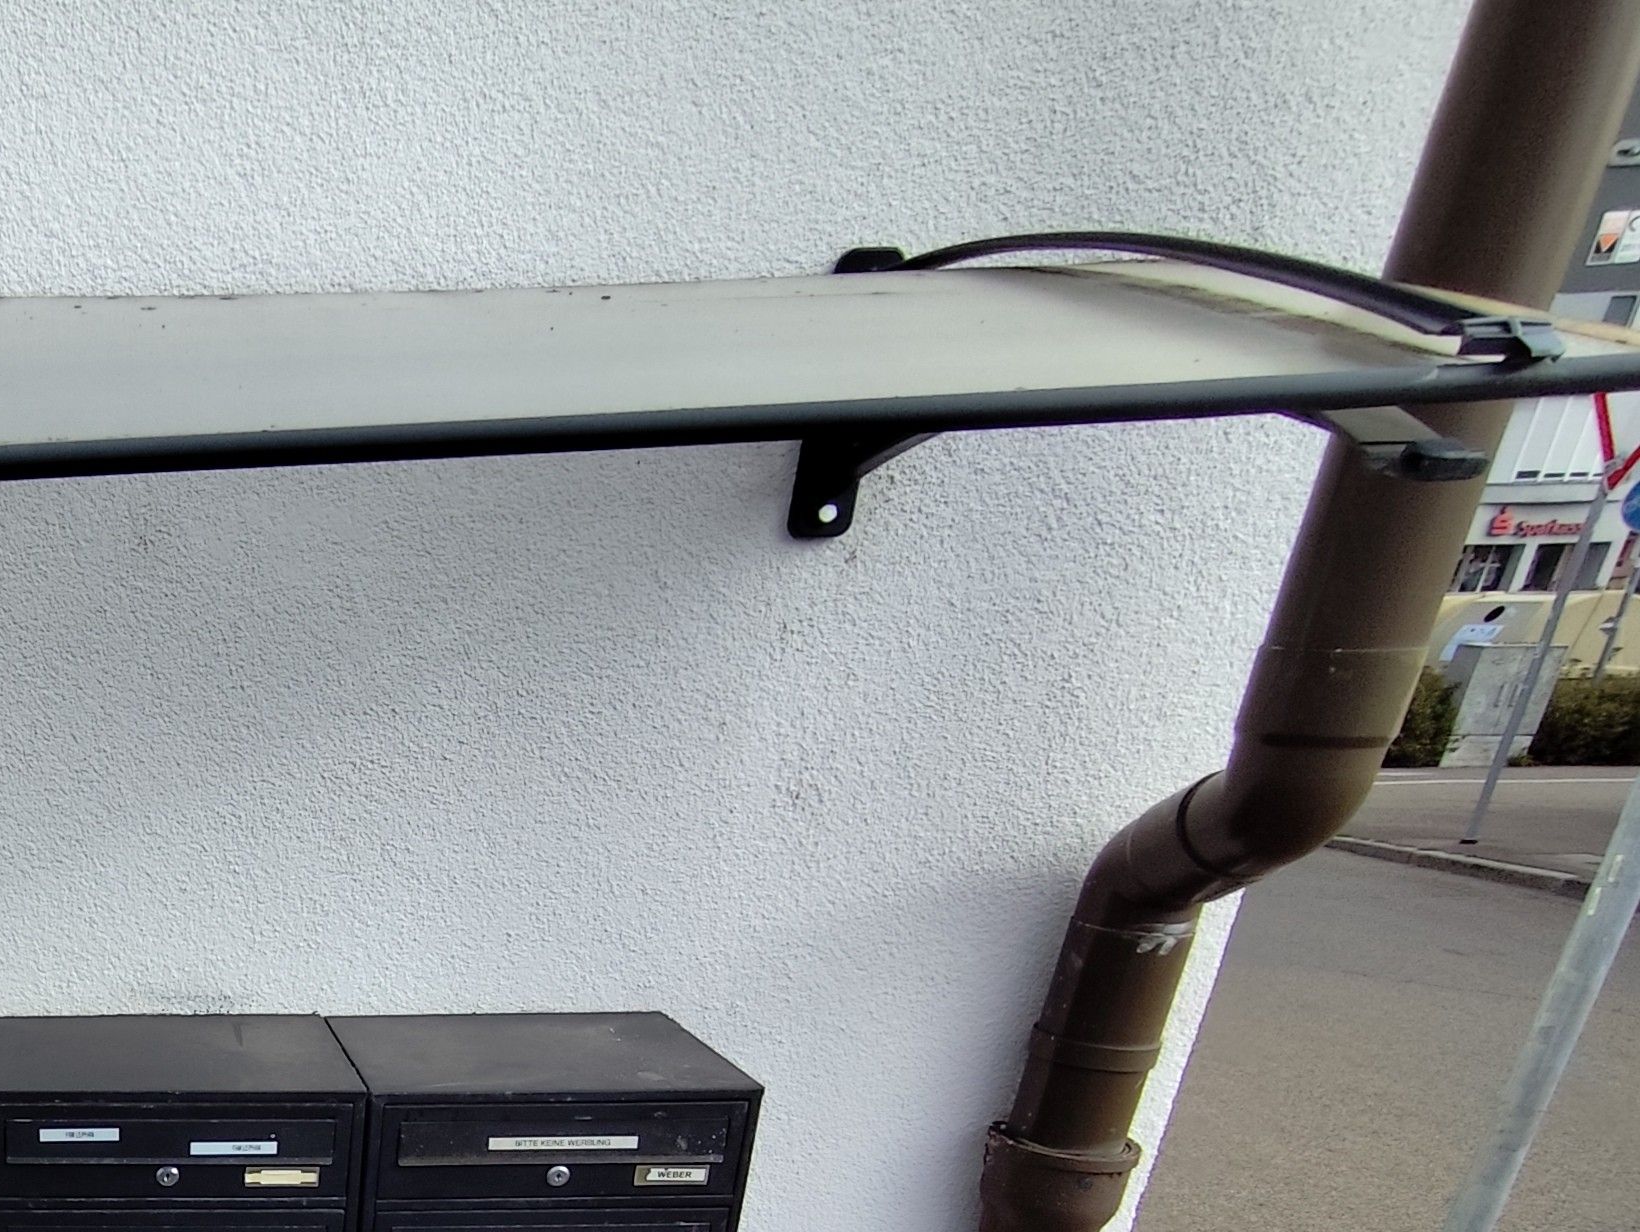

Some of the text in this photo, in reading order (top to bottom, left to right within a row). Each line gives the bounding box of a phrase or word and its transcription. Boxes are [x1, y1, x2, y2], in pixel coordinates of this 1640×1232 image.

[1515, 519, 1585, 538] Sparkass
[514, 1139, 538, 1147] BITTE
[567, 1138, 611, 1146] WERBUNG
[657, 1170, 692, 1179] WEBER
